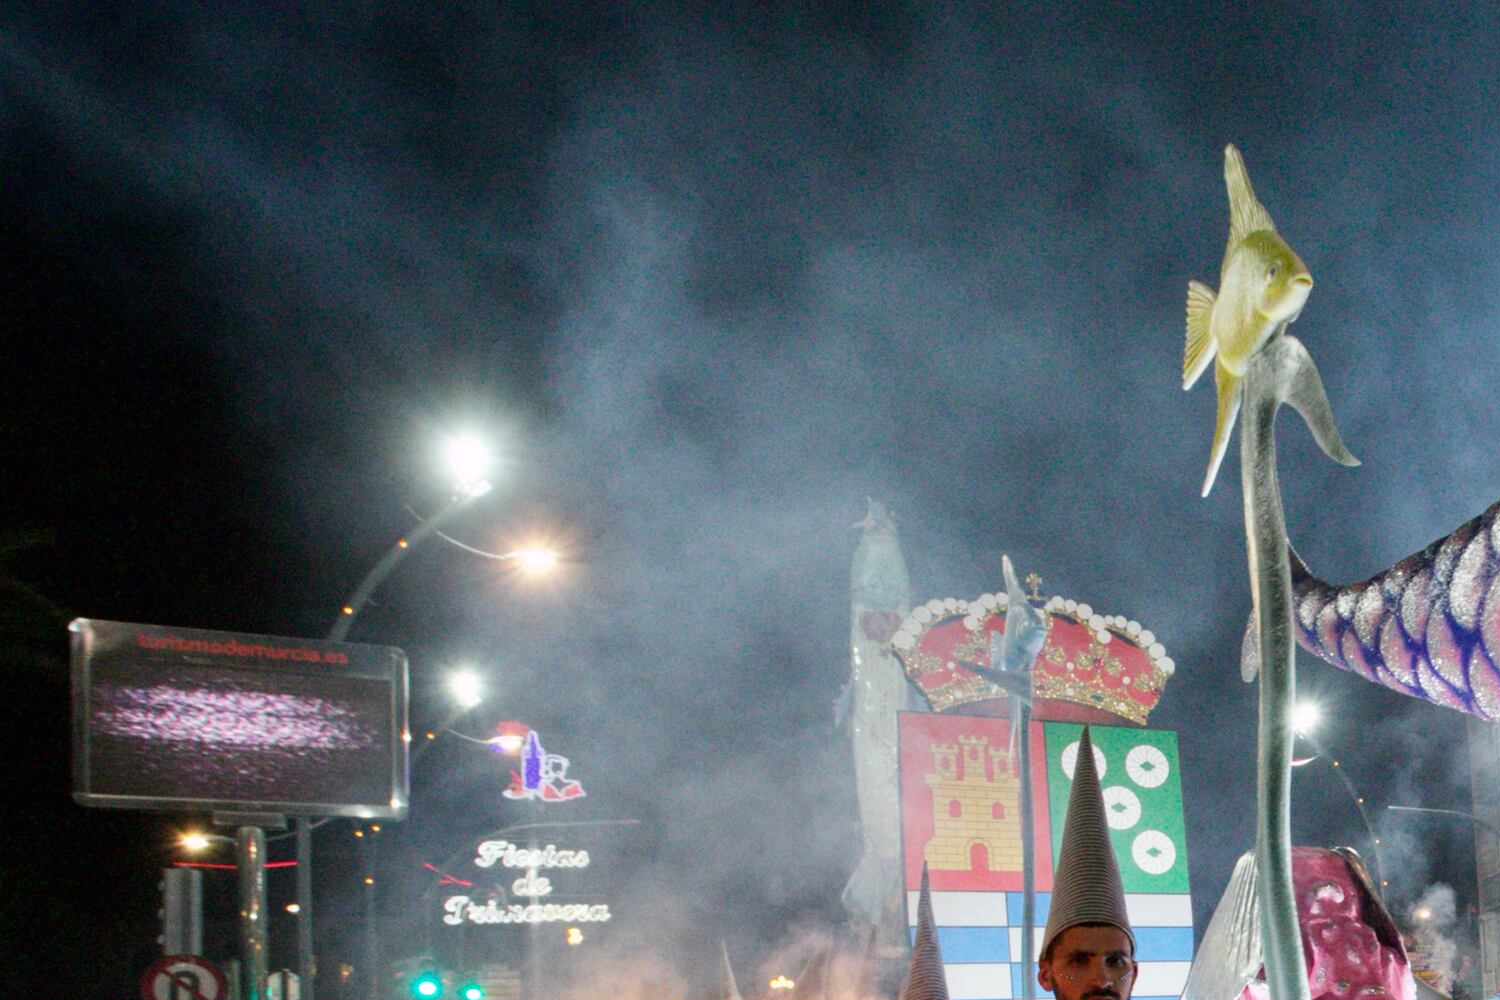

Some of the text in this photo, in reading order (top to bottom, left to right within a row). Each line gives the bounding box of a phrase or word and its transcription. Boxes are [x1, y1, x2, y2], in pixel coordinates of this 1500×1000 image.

[475, 841, 590, 868] Fiestas
[512, 869, 552, 896] de
[443, 896, 611, 925] Primavera
